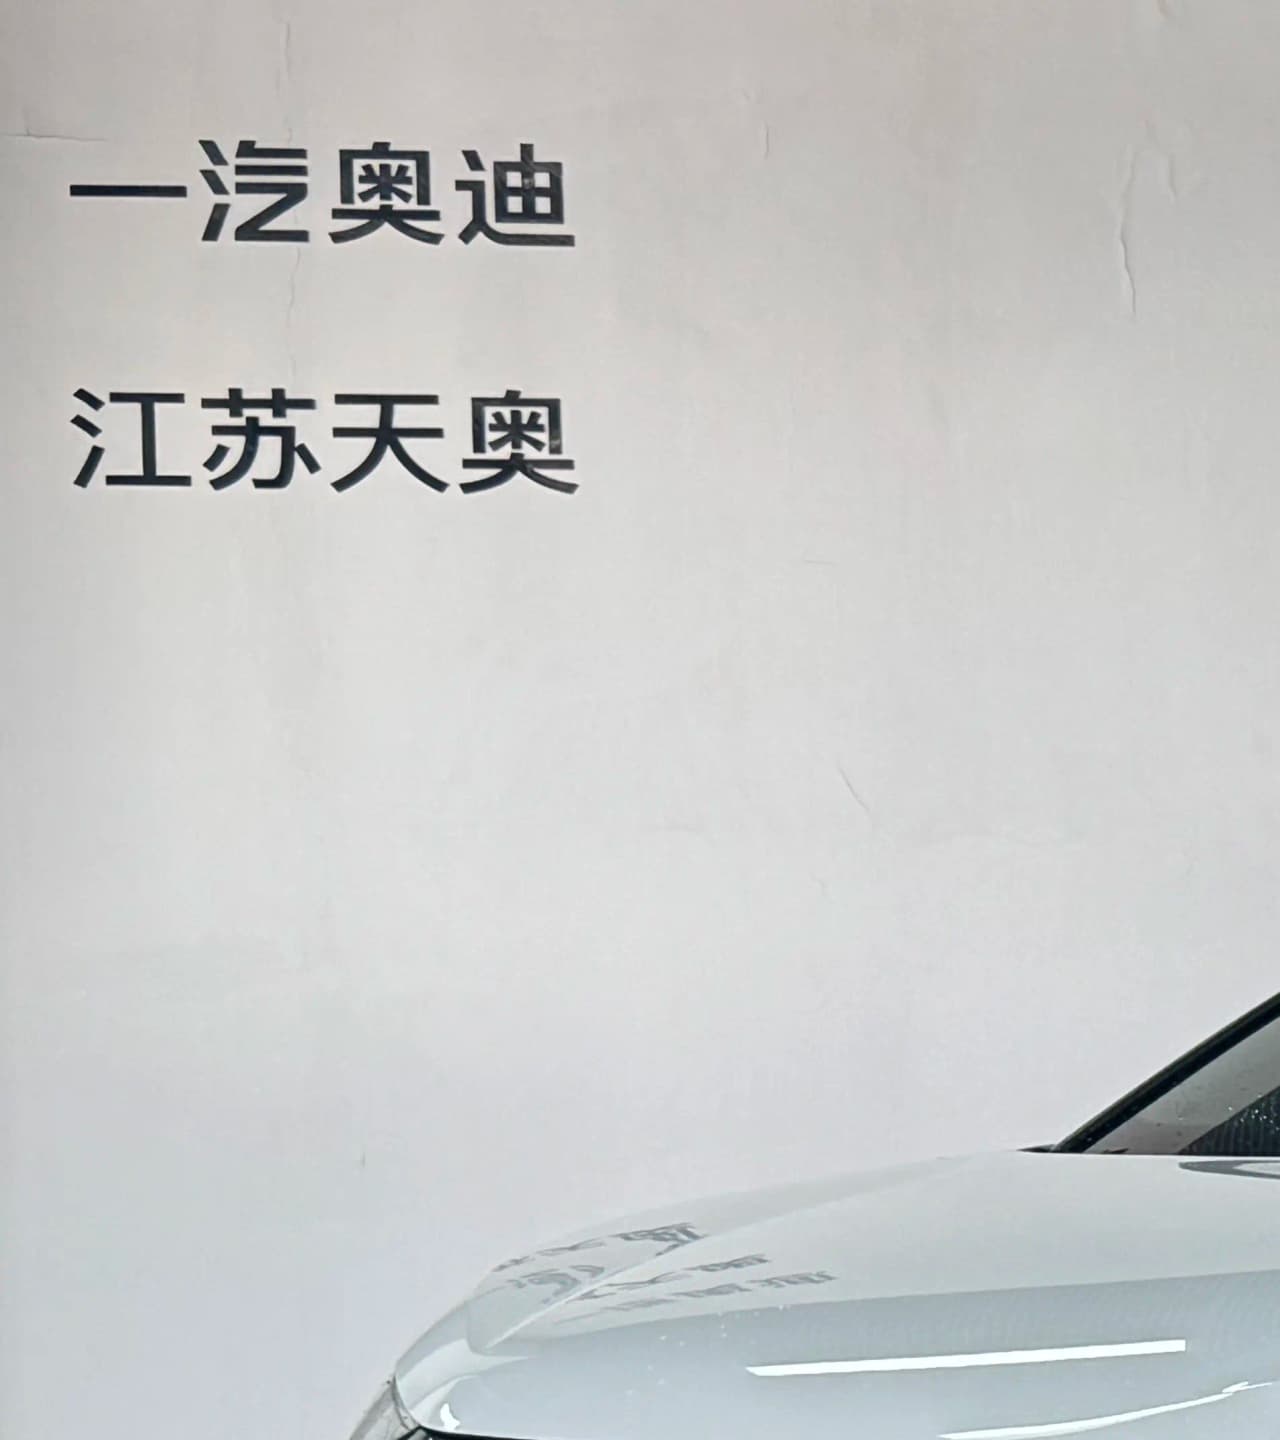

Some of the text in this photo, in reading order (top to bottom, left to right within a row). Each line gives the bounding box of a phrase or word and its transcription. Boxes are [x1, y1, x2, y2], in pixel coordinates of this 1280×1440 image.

[69, 139, 575, 247] 一汽奥迪
[70, 387, 579, 494] 江苏天奥
